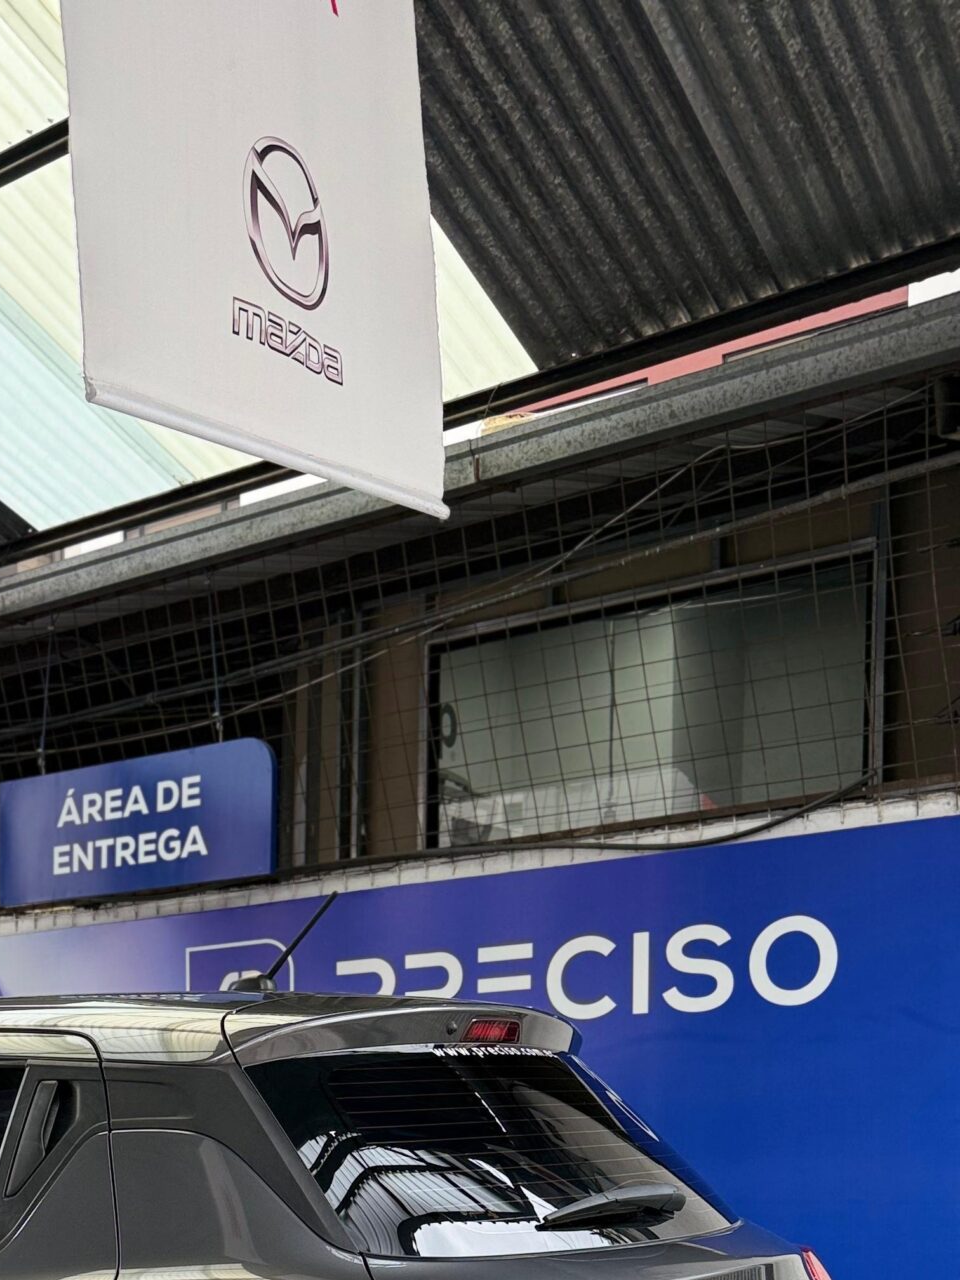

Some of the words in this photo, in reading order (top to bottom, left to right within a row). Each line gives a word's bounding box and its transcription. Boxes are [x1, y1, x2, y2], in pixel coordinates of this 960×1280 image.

[56, 785, 149, 828] ÁREA
[156, 775, 202, 813] DE
[53, 825, 208, 876] ENTREGA
